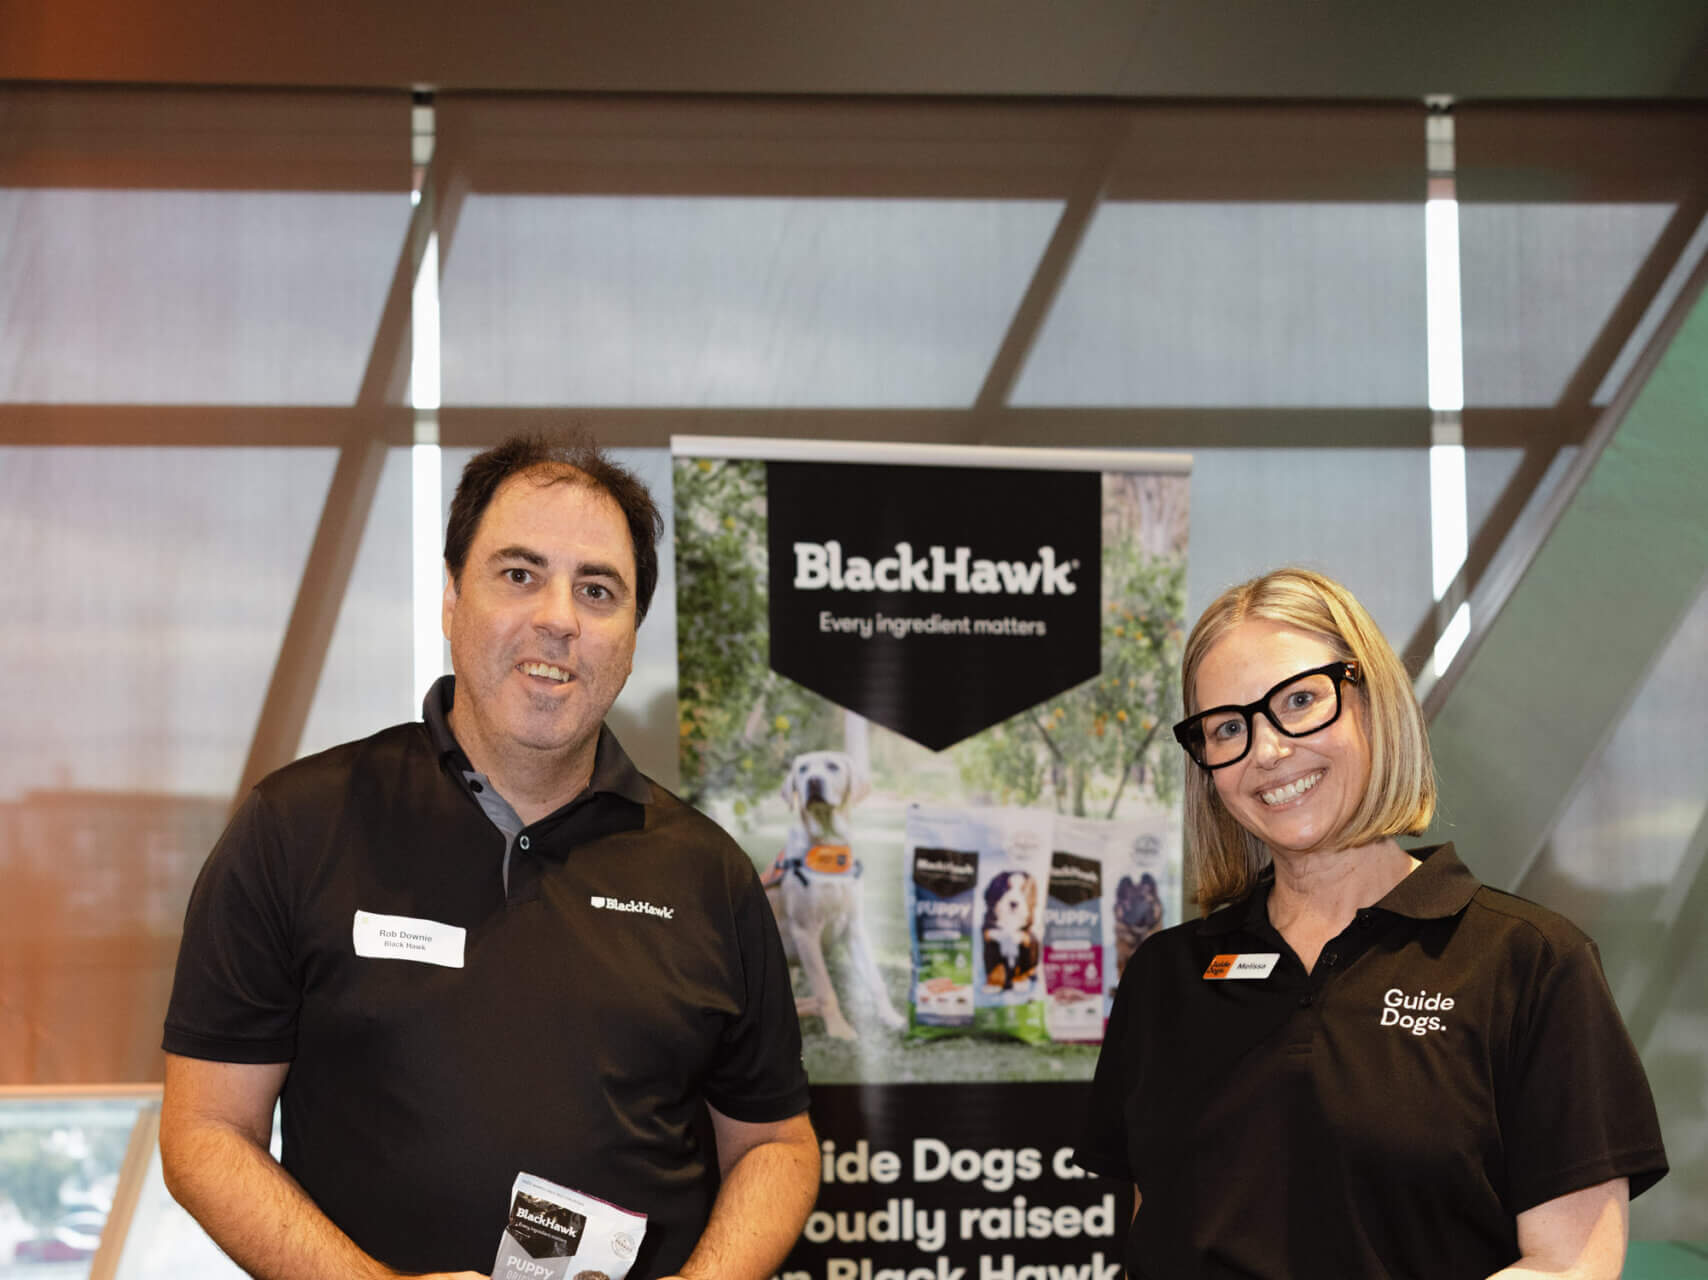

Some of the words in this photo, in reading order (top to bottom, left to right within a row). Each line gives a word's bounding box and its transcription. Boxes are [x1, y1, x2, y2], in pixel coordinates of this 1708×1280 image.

[793, 540, 1077, 595] BlackHawk
[819, 611, 873, 639] Every
[875, 613, 970, 639] ingredient
[973, 618, 1047, 636] matters
[379, 929, 398, 938] Rob
[1384, 988, 1455, 1011] Guide
[1380, 1007, 1447, 1036] Dogs.
[822, 1140, 901, 1183] ide
[914, 1138, 1043, 1191] Dogs
[516, 1207, 578, 1238] BlackHawk
[804, 1199, 946, 1252] oudly
[960, 1195, 1115, 1241] raised
[506, 1255, 555, 1280] PUPPY
